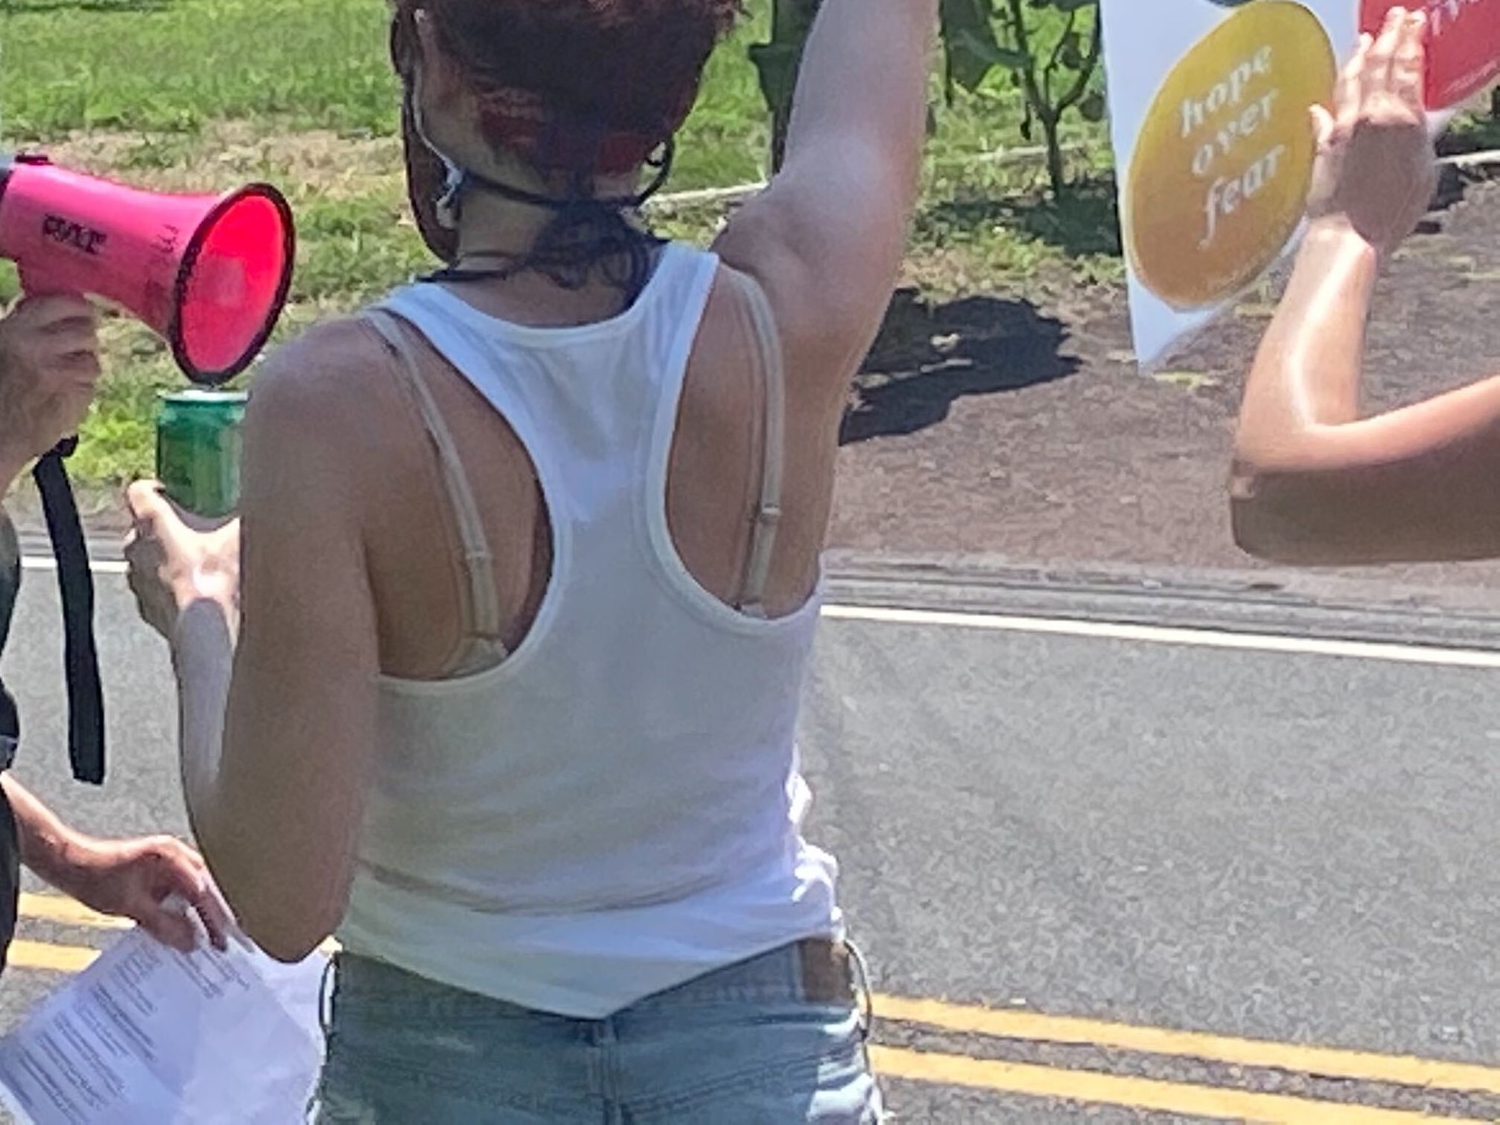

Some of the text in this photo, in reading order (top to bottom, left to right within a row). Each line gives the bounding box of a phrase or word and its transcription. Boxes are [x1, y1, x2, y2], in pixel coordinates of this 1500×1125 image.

[1181, 44, 1273, 139] hope
[1191, 88, 1280, 176] over
[1197, 143, 1285, 250] fear
